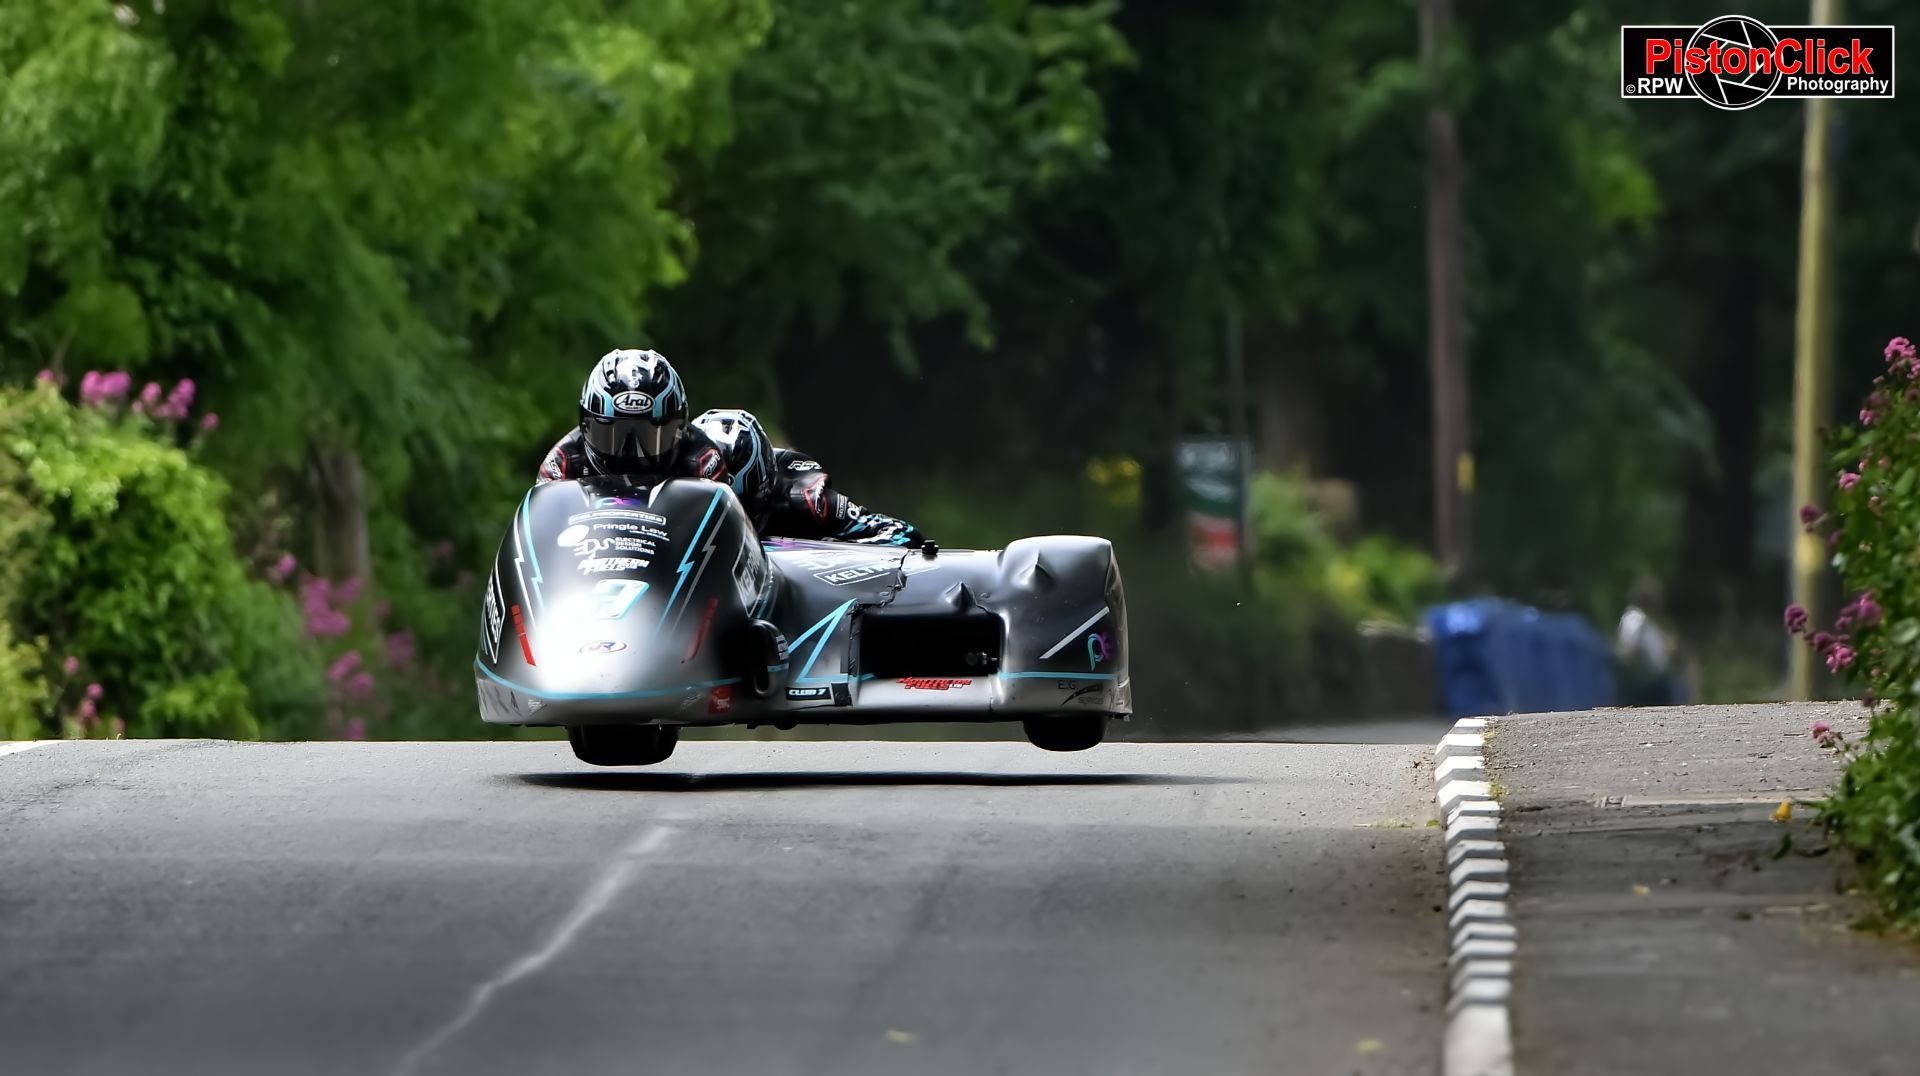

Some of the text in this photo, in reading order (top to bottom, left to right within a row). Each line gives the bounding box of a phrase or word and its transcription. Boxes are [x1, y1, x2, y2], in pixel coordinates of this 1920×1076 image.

[616, 394, 649, 406] Arai
[593, 523, 639, 531] Pringle
[641, 525, 668, 537] Law
[614, 536, 656, 547] ELECTRICAL
[614, 546, 655, 555] SOLUTIONS
